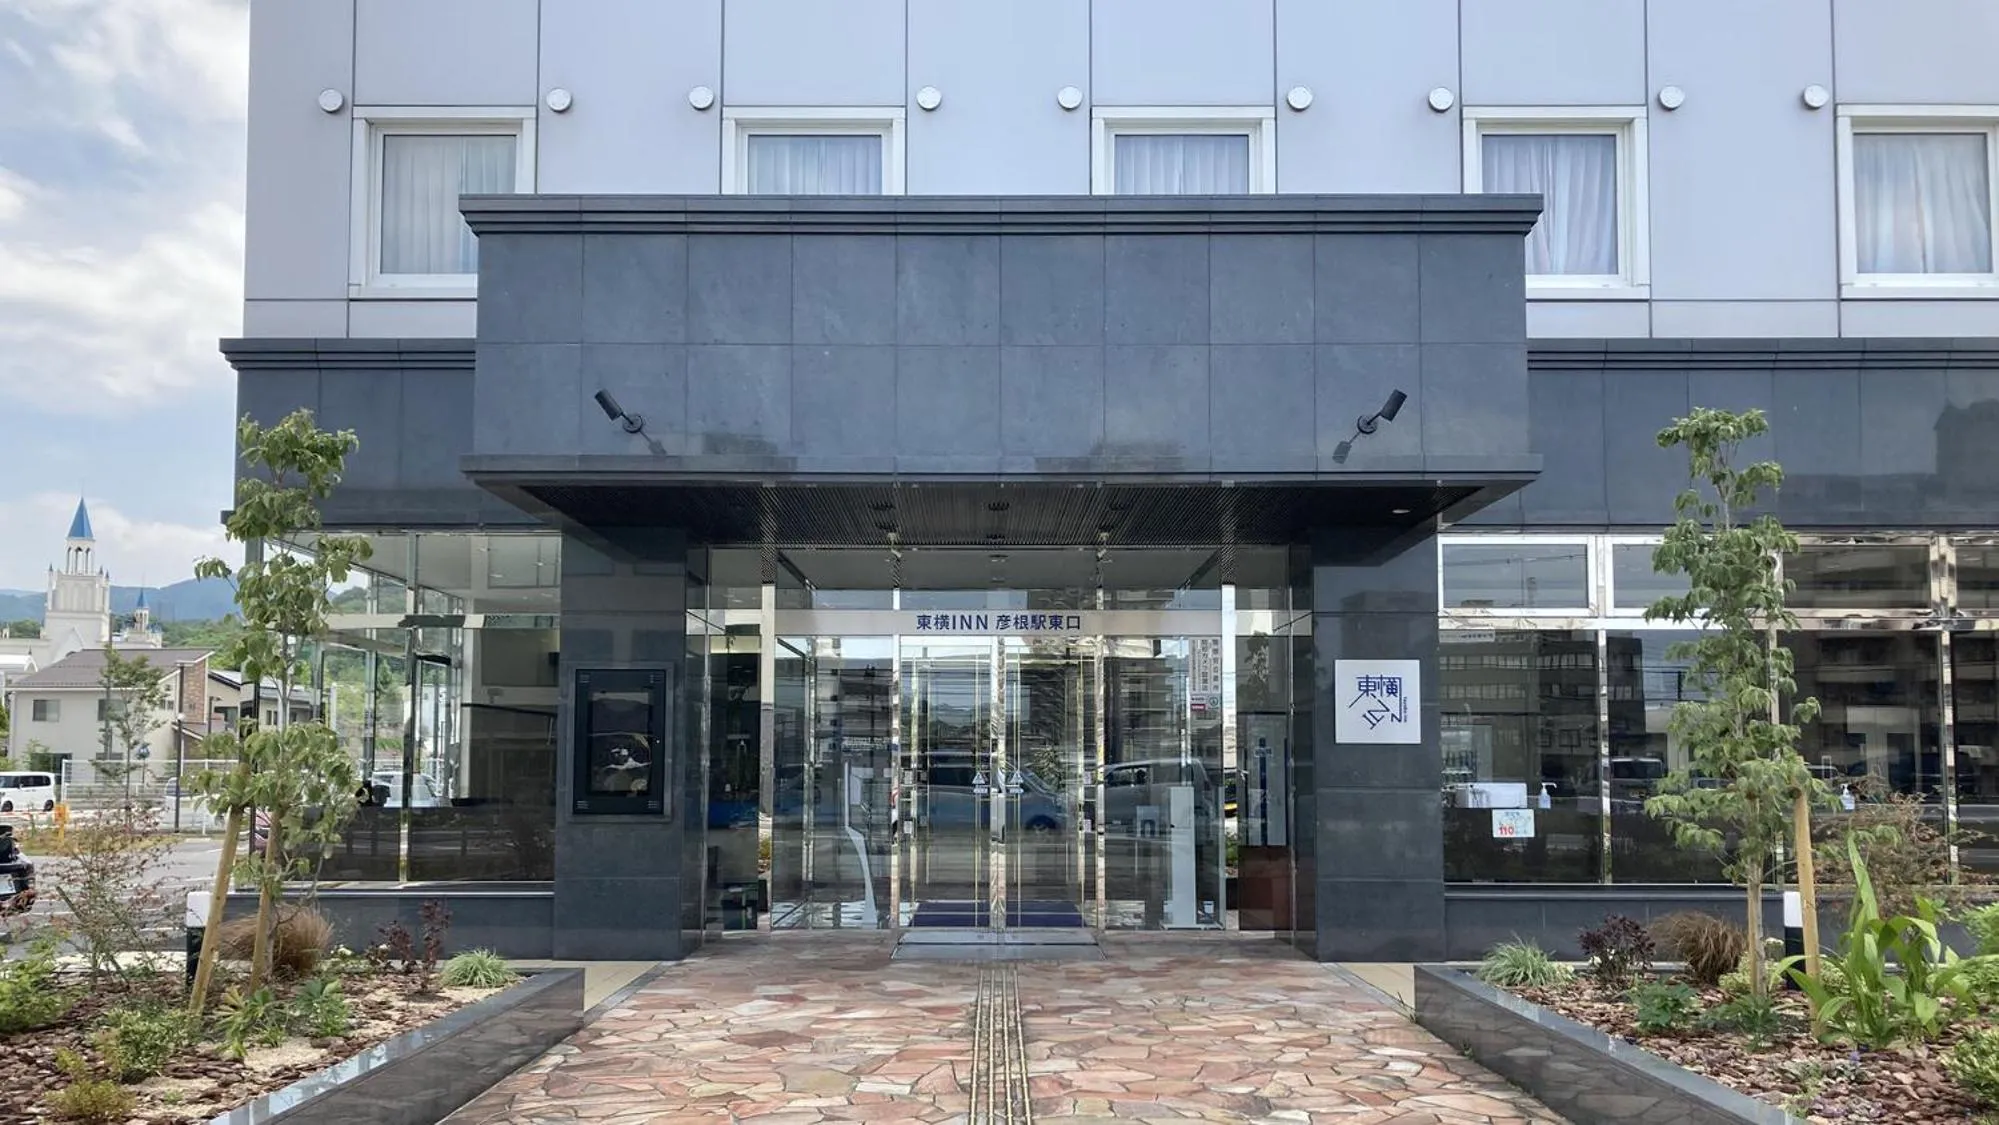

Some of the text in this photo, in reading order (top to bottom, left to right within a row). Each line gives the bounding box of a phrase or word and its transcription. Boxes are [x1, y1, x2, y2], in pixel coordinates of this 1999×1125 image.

[916, 614, 1082, 631] 東横INN 彦根駅東口
